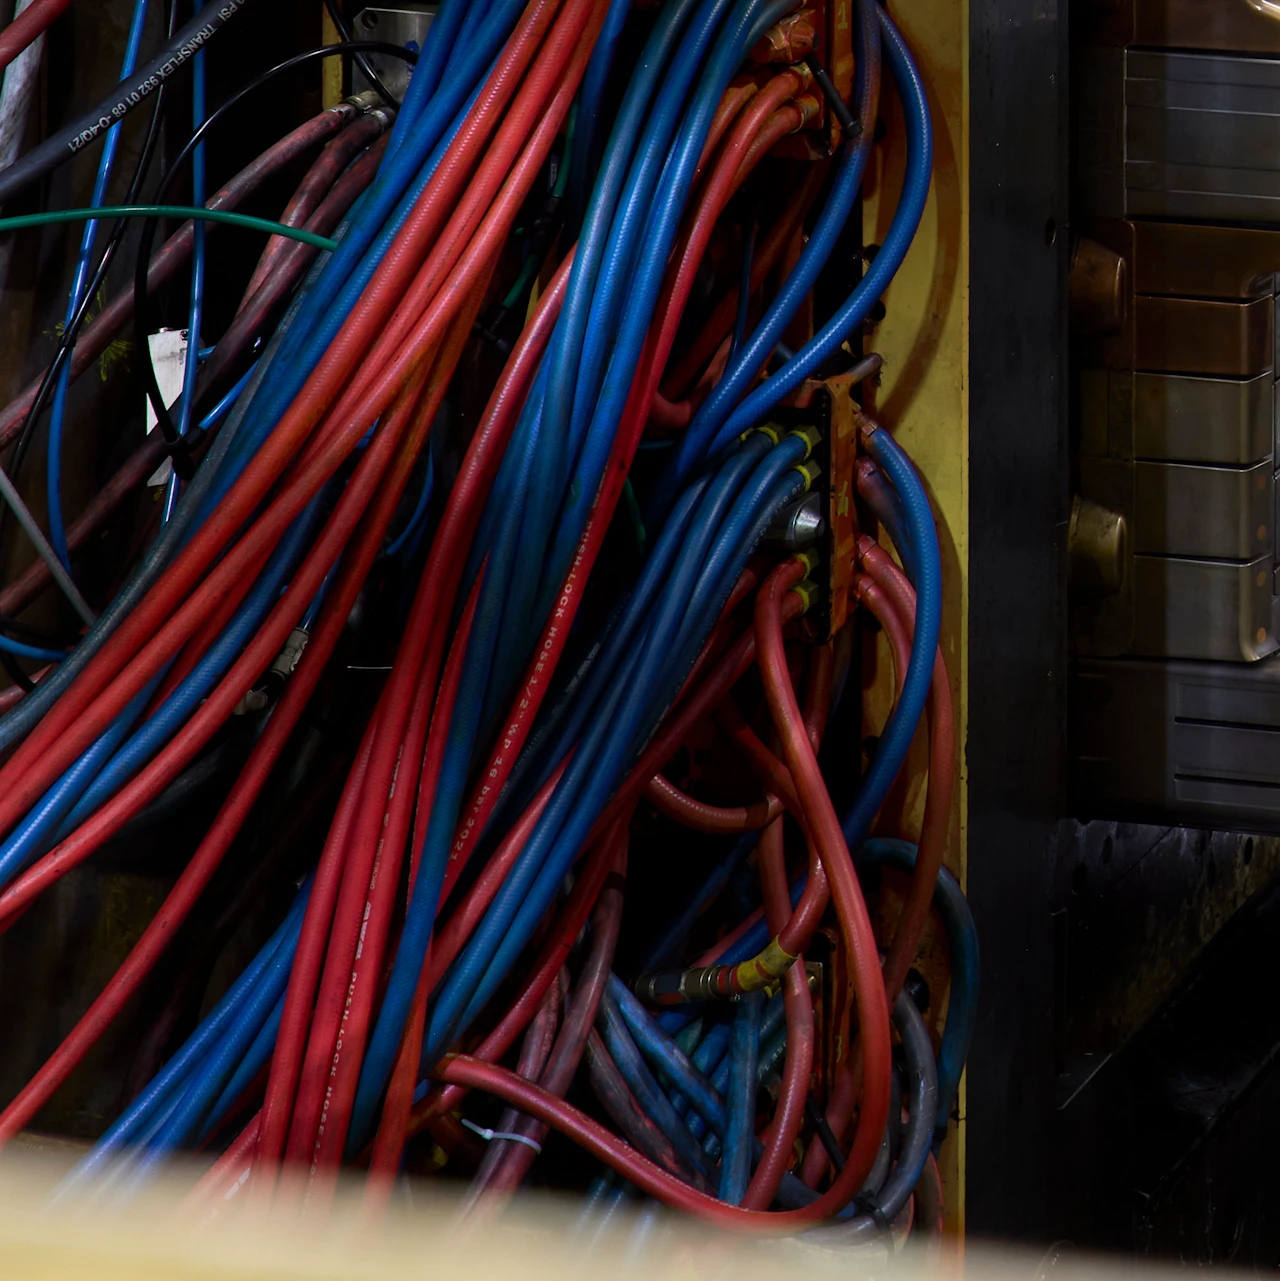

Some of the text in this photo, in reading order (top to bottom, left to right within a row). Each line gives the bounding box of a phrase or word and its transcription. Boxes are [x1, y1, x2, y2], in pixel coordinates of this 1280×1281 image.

[217, 1, 239, 22] PSI
[837, 0, 849, 30] 1
[156, 23, 218, 81] TRANSFLEX
[125, 92, 141, 107] 01
[137, 76, 160, 96] 932
[534, 626, 558, 673] HOSE
[503, 723, 519, 749] WP
[488, 756, 503, 779] 16
[449, 817, 475, 861] 2021
[317, 1085, 333, 1136] HOSE
